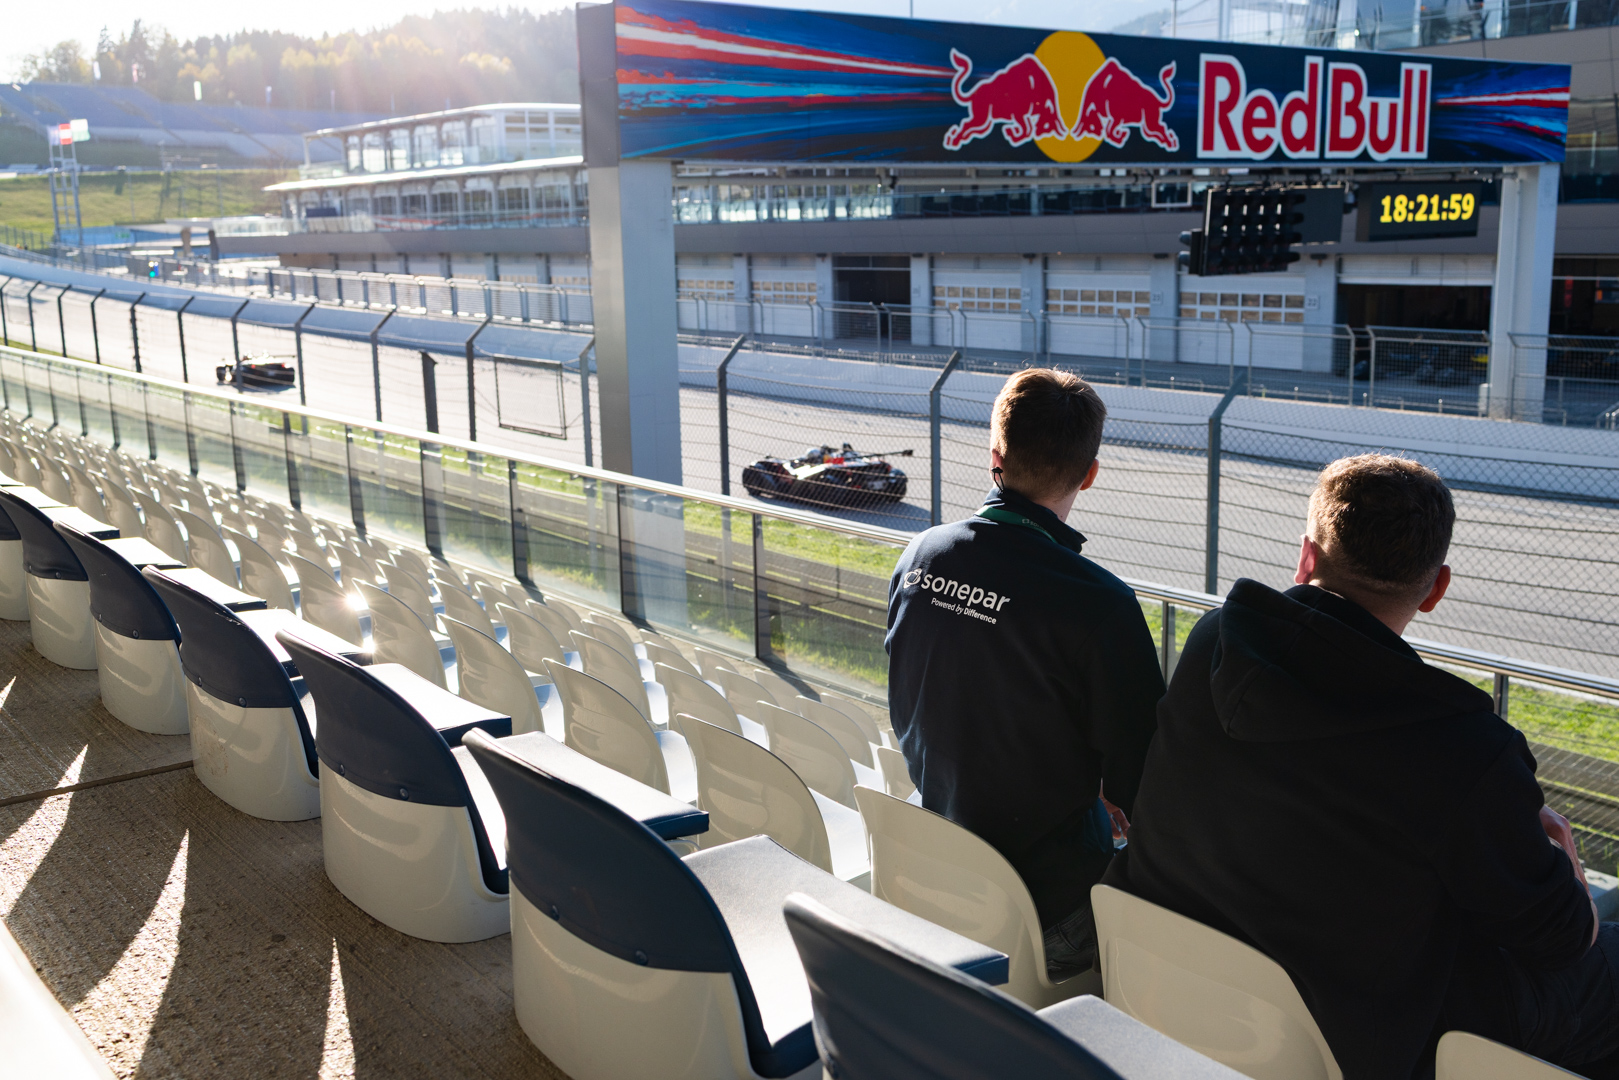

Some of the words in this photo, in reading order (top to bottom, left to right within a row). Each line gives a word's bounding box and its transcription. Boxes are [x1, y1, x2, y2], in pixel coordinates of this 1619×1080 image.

[1198, 54, 1323, 159] Red
[1325, 62, 1431, 161] Bull
[1380, 193, 1475, 223] 18:21:59
[921, 573, 1011, 612] sonepar
[930, 597, 956, 611] Powered
[955, 604, 964, 615] by
[963, 607, 997, 625] Difference
